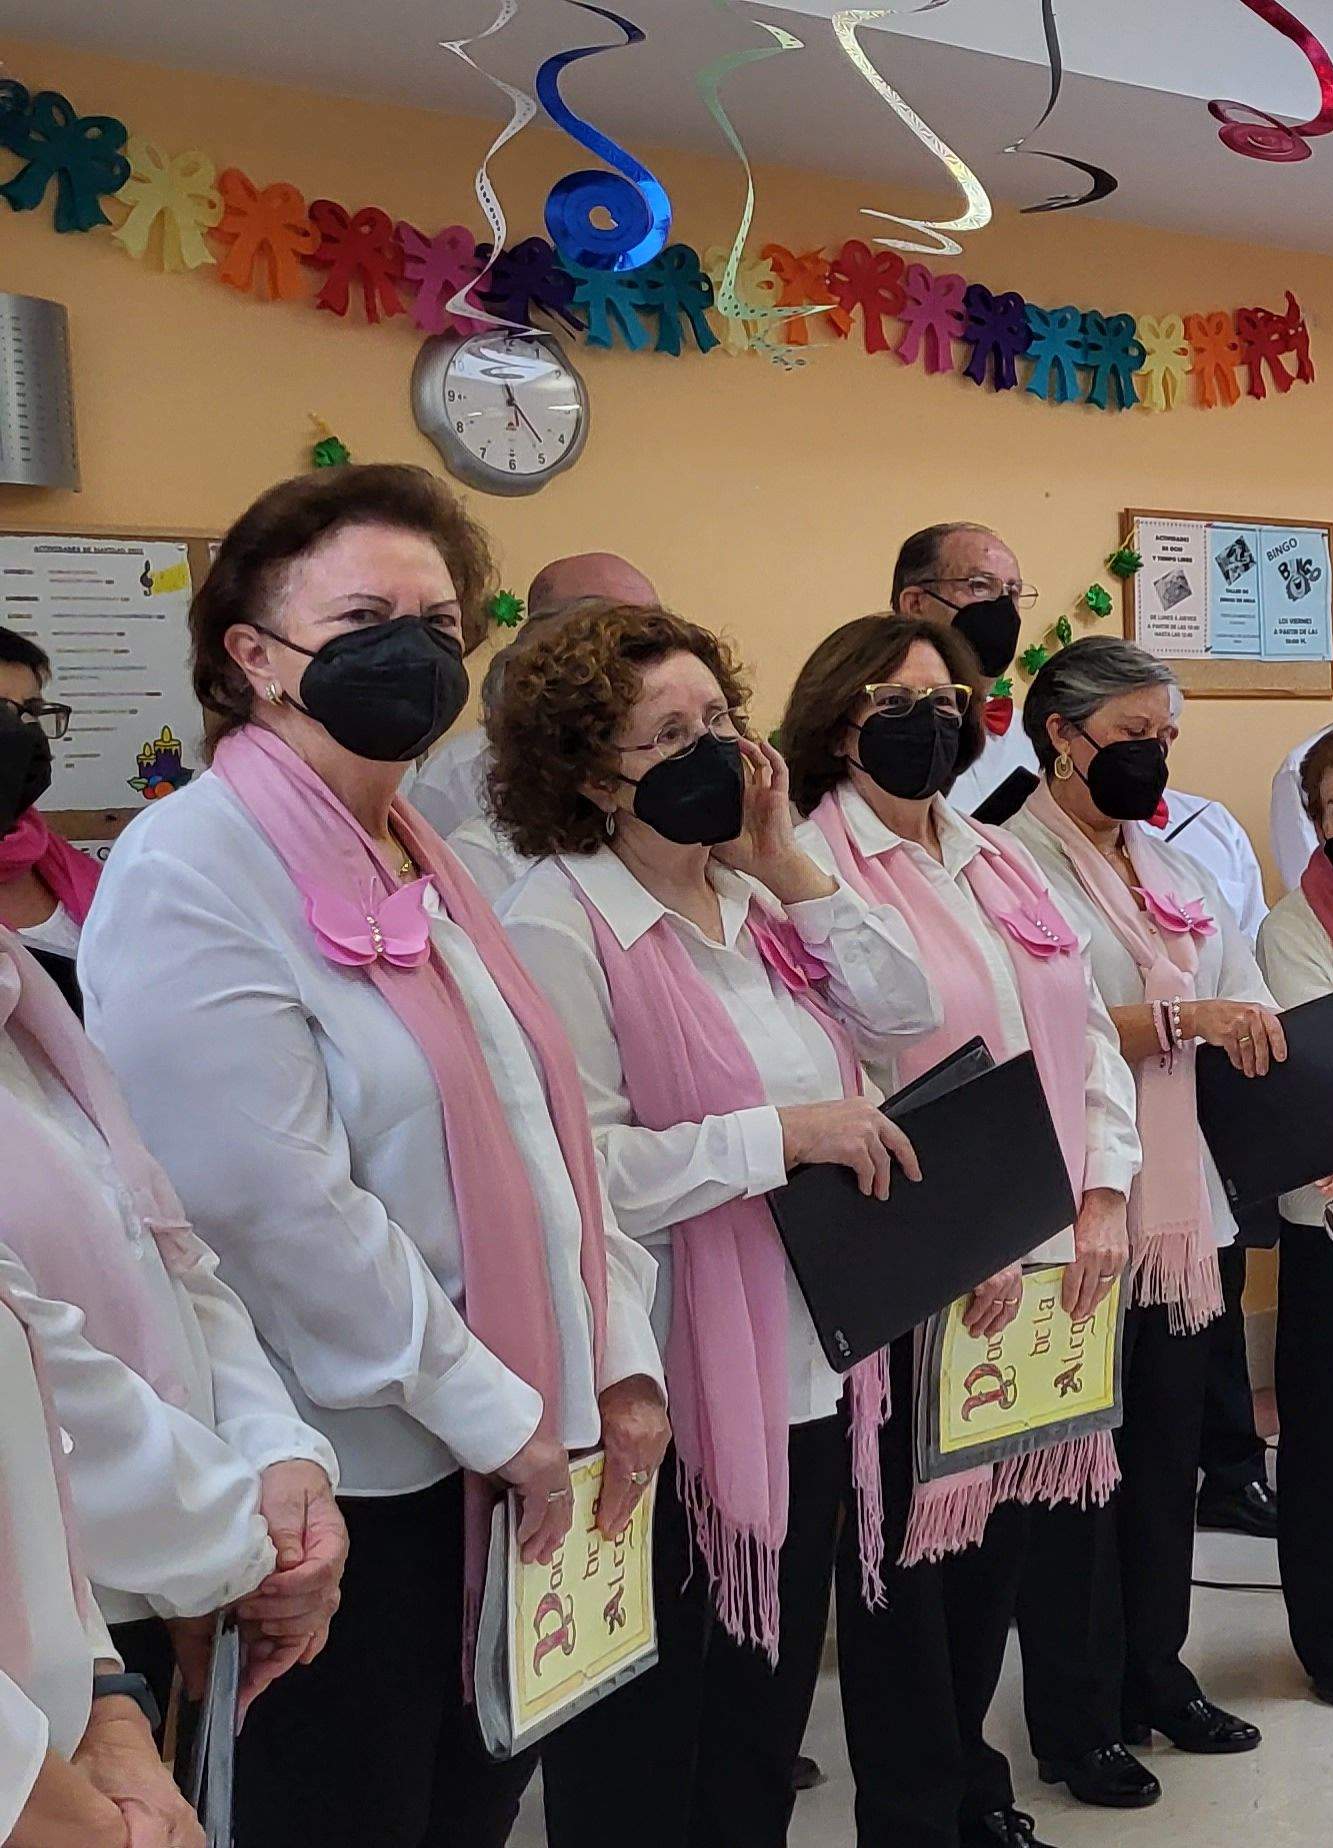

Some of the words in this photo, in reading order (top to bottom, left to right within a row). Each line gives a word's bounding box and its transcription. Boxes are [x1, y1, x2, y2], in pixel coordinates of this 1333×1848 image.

[448, 391, 455, 402] 9
[457, 421, 464, 433] 8
[558, 434, 565, 444] 4
[480, 448, 487, 459] 7
[538, 453, 545, 465] 5
[509, 459, 516, 470] 6
[1266, 537, 1298, 561] BINGO
[1054, 1315, 1096, 1398] Aleg
